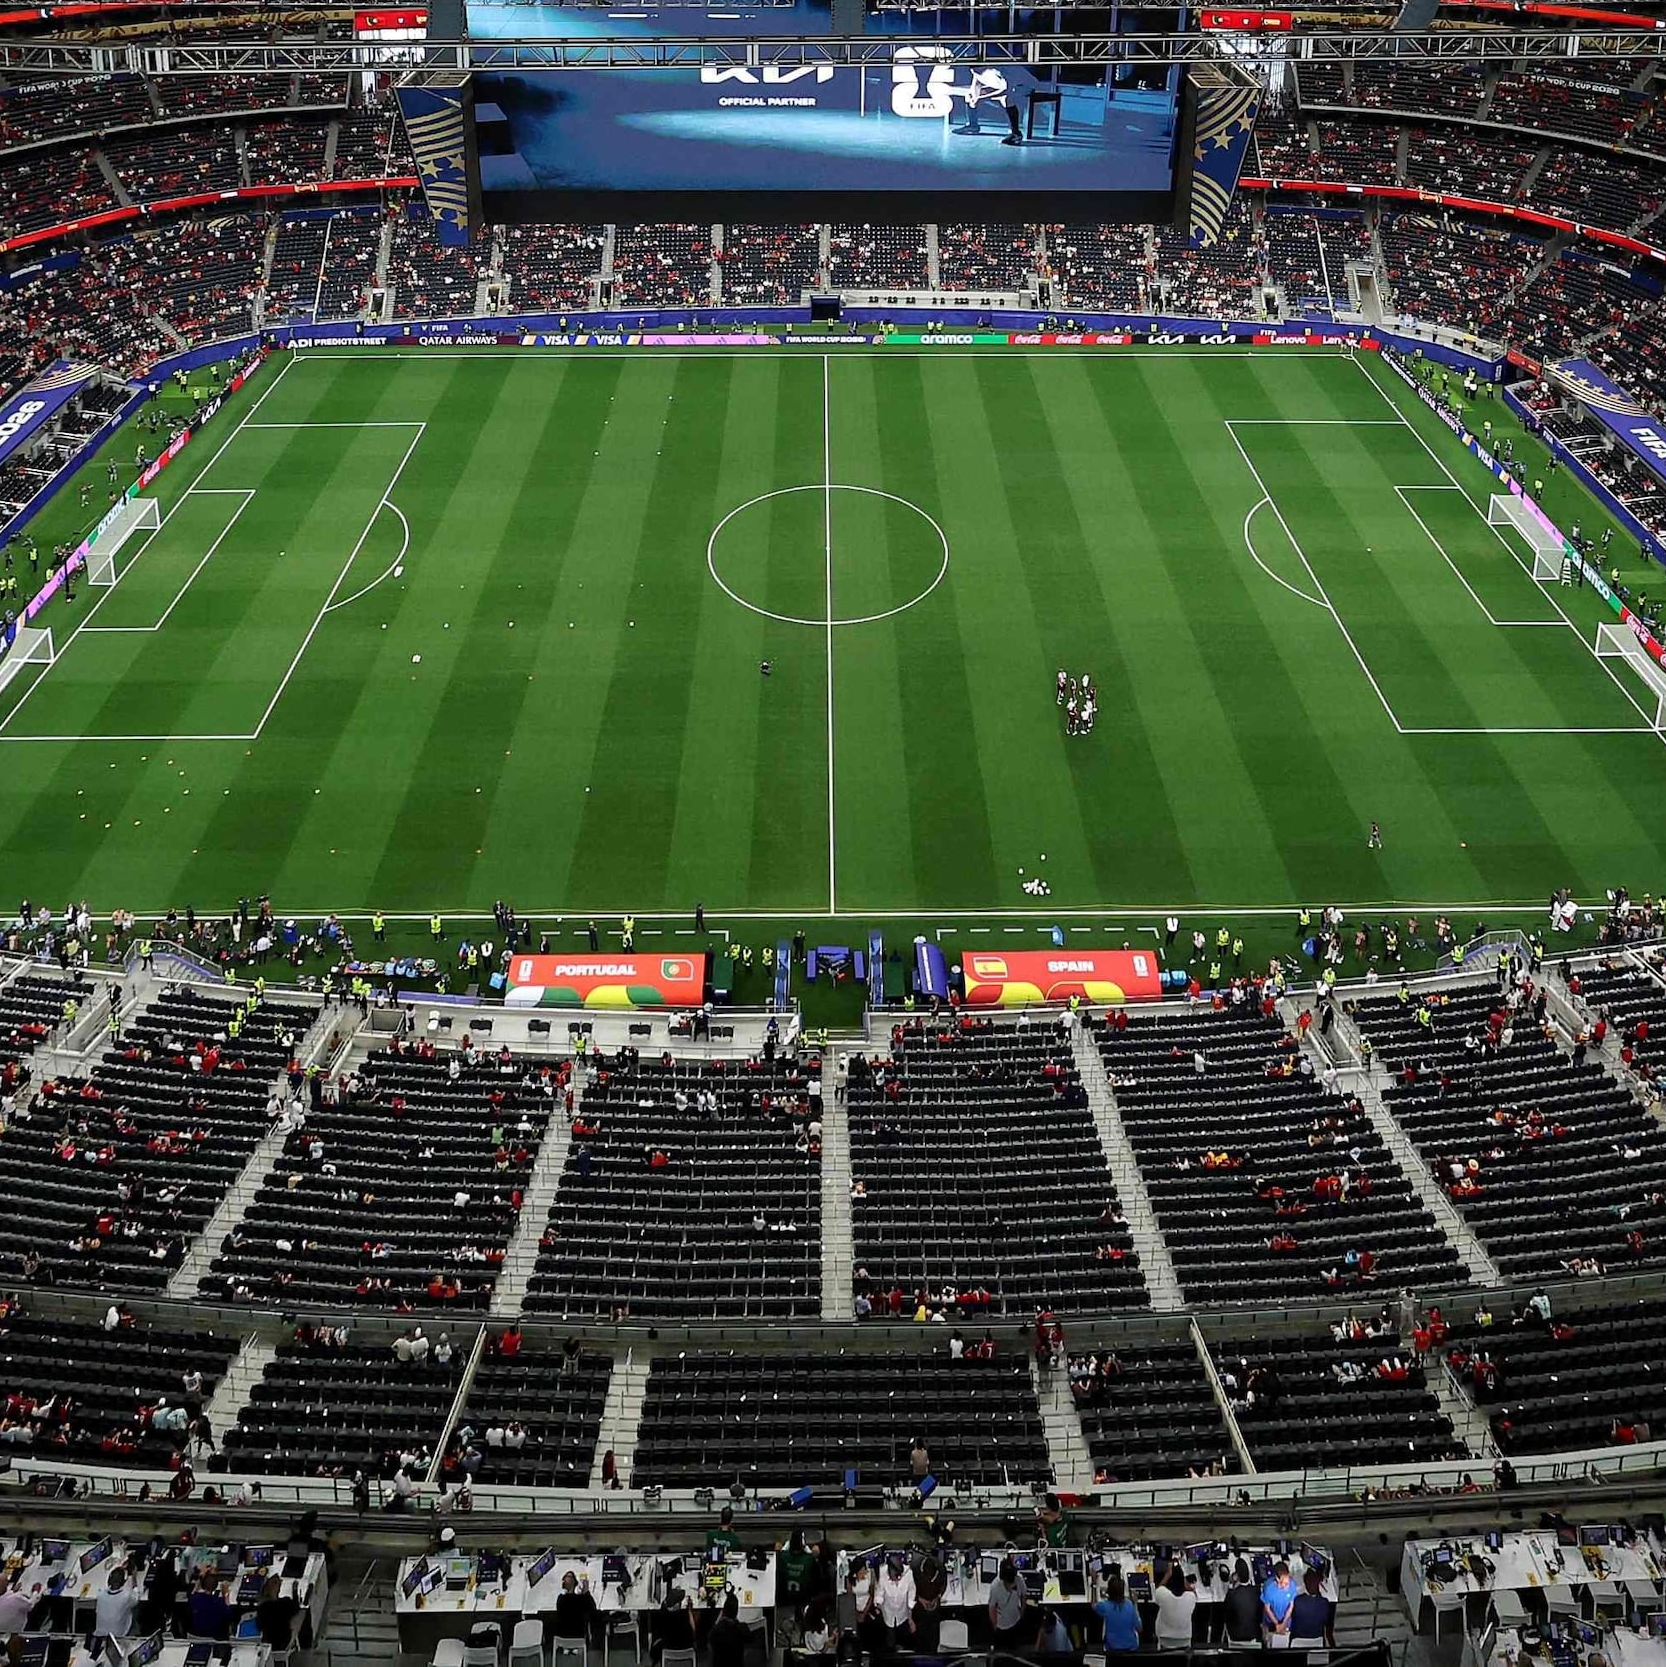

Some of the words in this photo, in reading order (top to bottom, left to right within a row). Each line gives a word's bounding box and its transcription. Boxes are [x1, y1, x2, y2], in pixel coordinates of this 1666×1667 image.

[719, 97, 766, 107] OFFICIAL
[767, 97, 816, 107] PARTNER
[286, 337, 313, 349] ADI
[418, 335, 453, 346] QATAR
[455, 335, 498, 346] AIRWAYS
[544, 335, 570, 346] VISA
[596, 335, 623, 346] VISA
[920, 334, 973, 345] aramco
[1270, 334, 1307, 345] Lenovo
[554, 964, 637, 976] PORTUGAL
[1047, 960, 1095, 972] SPAIN
